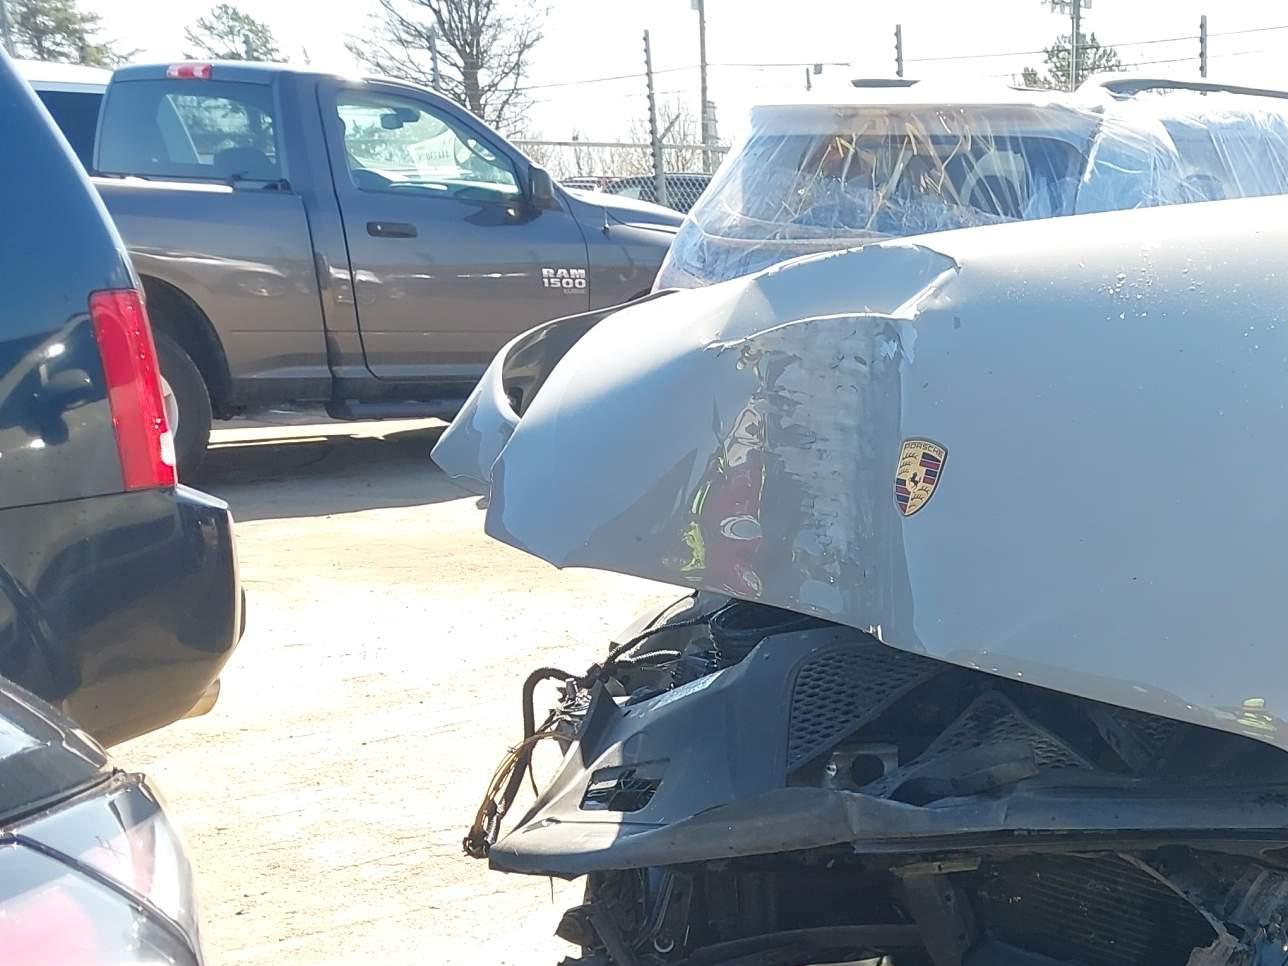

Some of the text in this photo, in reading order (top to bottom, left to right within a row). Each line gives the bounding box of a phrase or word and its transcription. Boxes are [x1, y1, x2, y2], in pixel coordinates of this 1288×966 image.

[542, 268, 586, 278] RAM
[543, 278, 586, 288] 1500
[904, 442, 944, 458] PORSCHE
